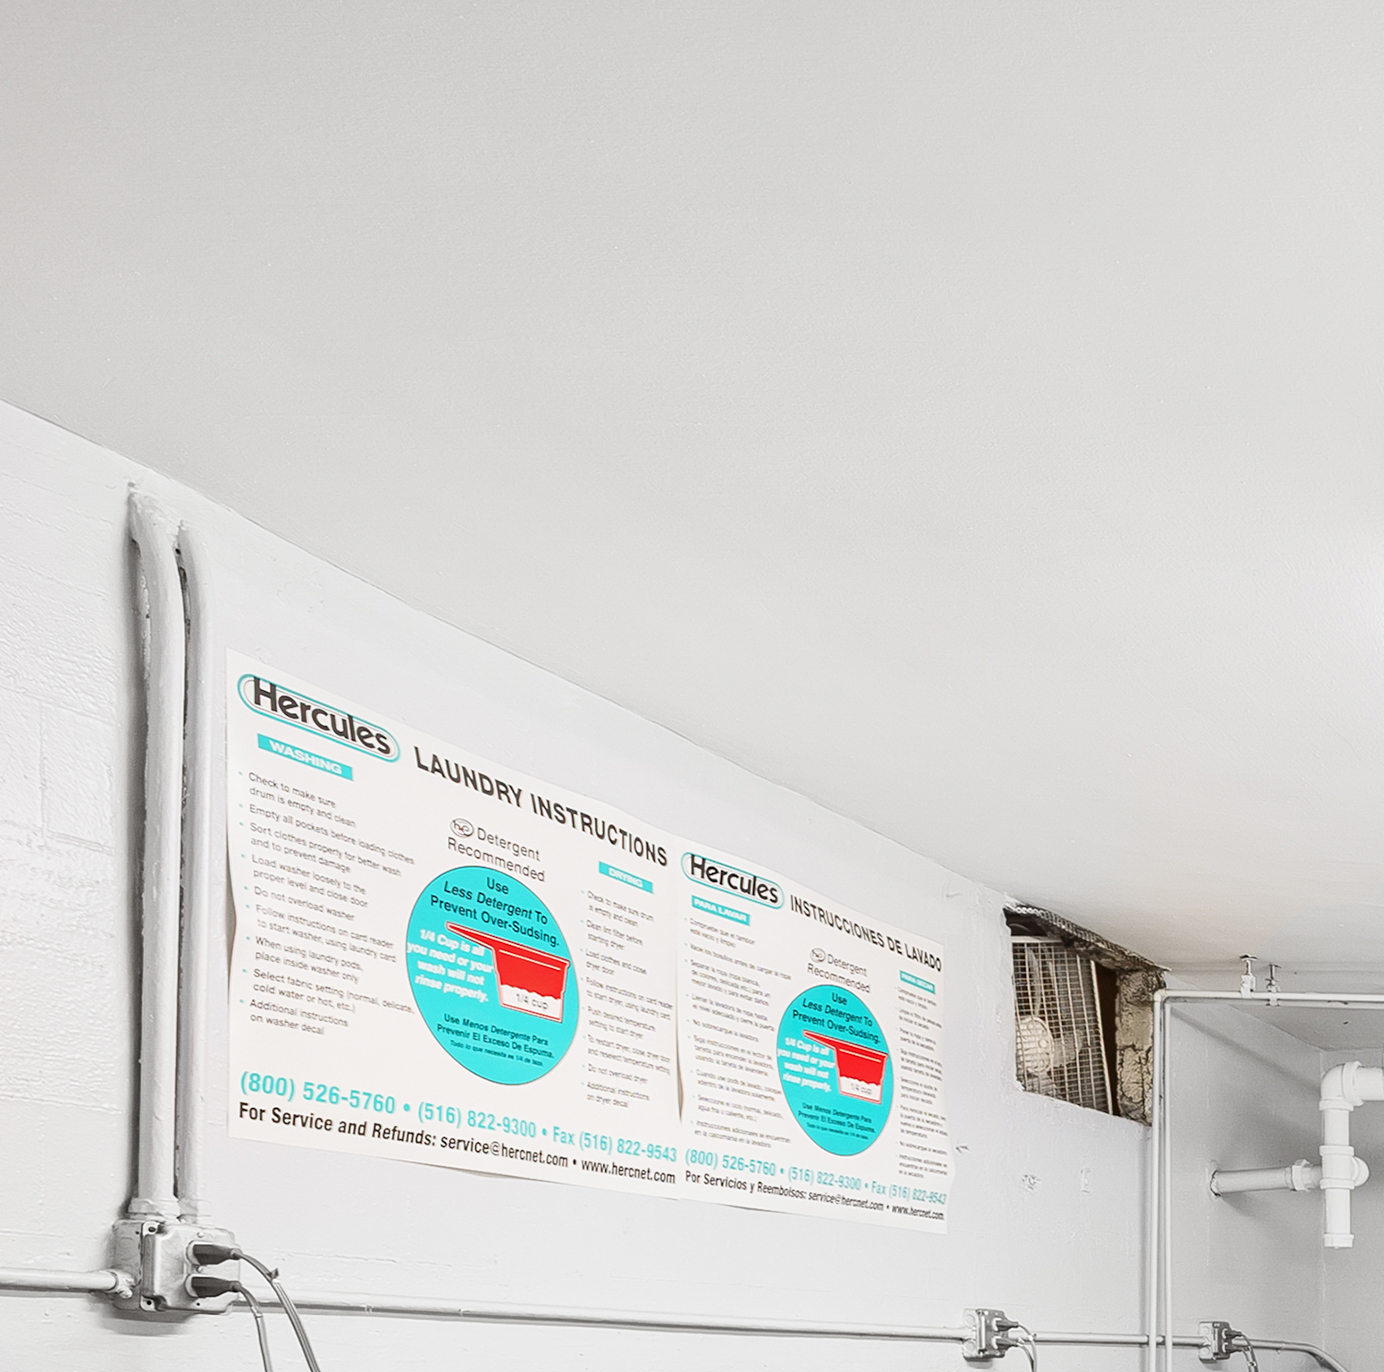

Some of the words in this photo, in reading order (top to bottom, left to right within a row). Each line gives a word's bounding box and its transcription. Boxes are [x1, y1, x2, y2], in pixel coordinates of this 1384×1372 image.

[253, 676, 391, 755] Hercules
[269, 740, 343, 774] WASHING
[414, 746, 522, 808] LAUNDRY
[530, 793, 668, 867] INSTRUCTIONS
[447, 837, 545, 882] Recommended
[477, 827, 541, 862] Detergent
[486, 877, 509, 895] Use
[690, 853, 779, 905] Hercules
[430, 895, 477, 920] Prevent
[481, 911, 560, 947] Over-Sudsing.
[443, 881, 472, 900] Less
[476, 892, 533, 920] Detergent
[535, 910, 548, 925] To
[790, 894, 885, 948] INSTRUCCIONES
[887, 936, 903, 955] DE
[904, 943, 942, 973] LAVADO
[807, 963, 871, 993] Recommended
[827, 953, 868, 977] Detergent
[802, 998, 822, 1013] Less
[824, 1005, 863, 1024] Detergent
[864, 1016, 873, 1027] To
[831, 992, 847, 1006] Use
[437, 1023, 470, 1040] Prevenir
[473, 1032, 481, 1041] El
[483, 1034, 510, 1049] Exceso
[512, 1041, 522, 1051] De
[443, 1013, 460, 1025] Use
[462, 1018, 489, 1032] Menos
[491, 1024, 530, 1043] Detergente
[532, 1035, 548, 1046] Para
[792, 1009, 825, 1027] Prevent
[827, 1020, 881, 1045] Over-Sudsing.
[240, 1070, 295, 1102] (800)
[302, 1081, 396, 1114] 526-5760
[418, 1101, 462, 1129] (516)
[467, 1109, 536, 1138] 822-9300
[553, 1126, 576, 1146] Fax
[579, 1131, 613, 1155] (516)
[616, 1138, 677, 1163] 822-9543
[239, 1101, 267, 1121] For
[271, 1107, 333, 1132] Service
[338, 1120, 367, 1136] and
[371, 1123, 437, 1147] Refunds:
[440, 1135, 568, 1168] service@hercnet.com
[581, 1157, 676, 1184] www.hercnet.com
[685, 1147, 718, 1171] (800)
[722, 1154, 776, 1177] 526-5760
[788, 1166, 814, 1187] (516)
[816, 1169, 861, 1192] 822-9300
[871, 1180, 887, 1196] Fax
[888, 1183, 911, 1201] (516)
[685, 1170, 701, 1185] Por
[702, 1173, 748, 1191] Servicios
[749, 1181, 755, 1193] y
[757, 1181, 807, 1200] Reembolsos:
